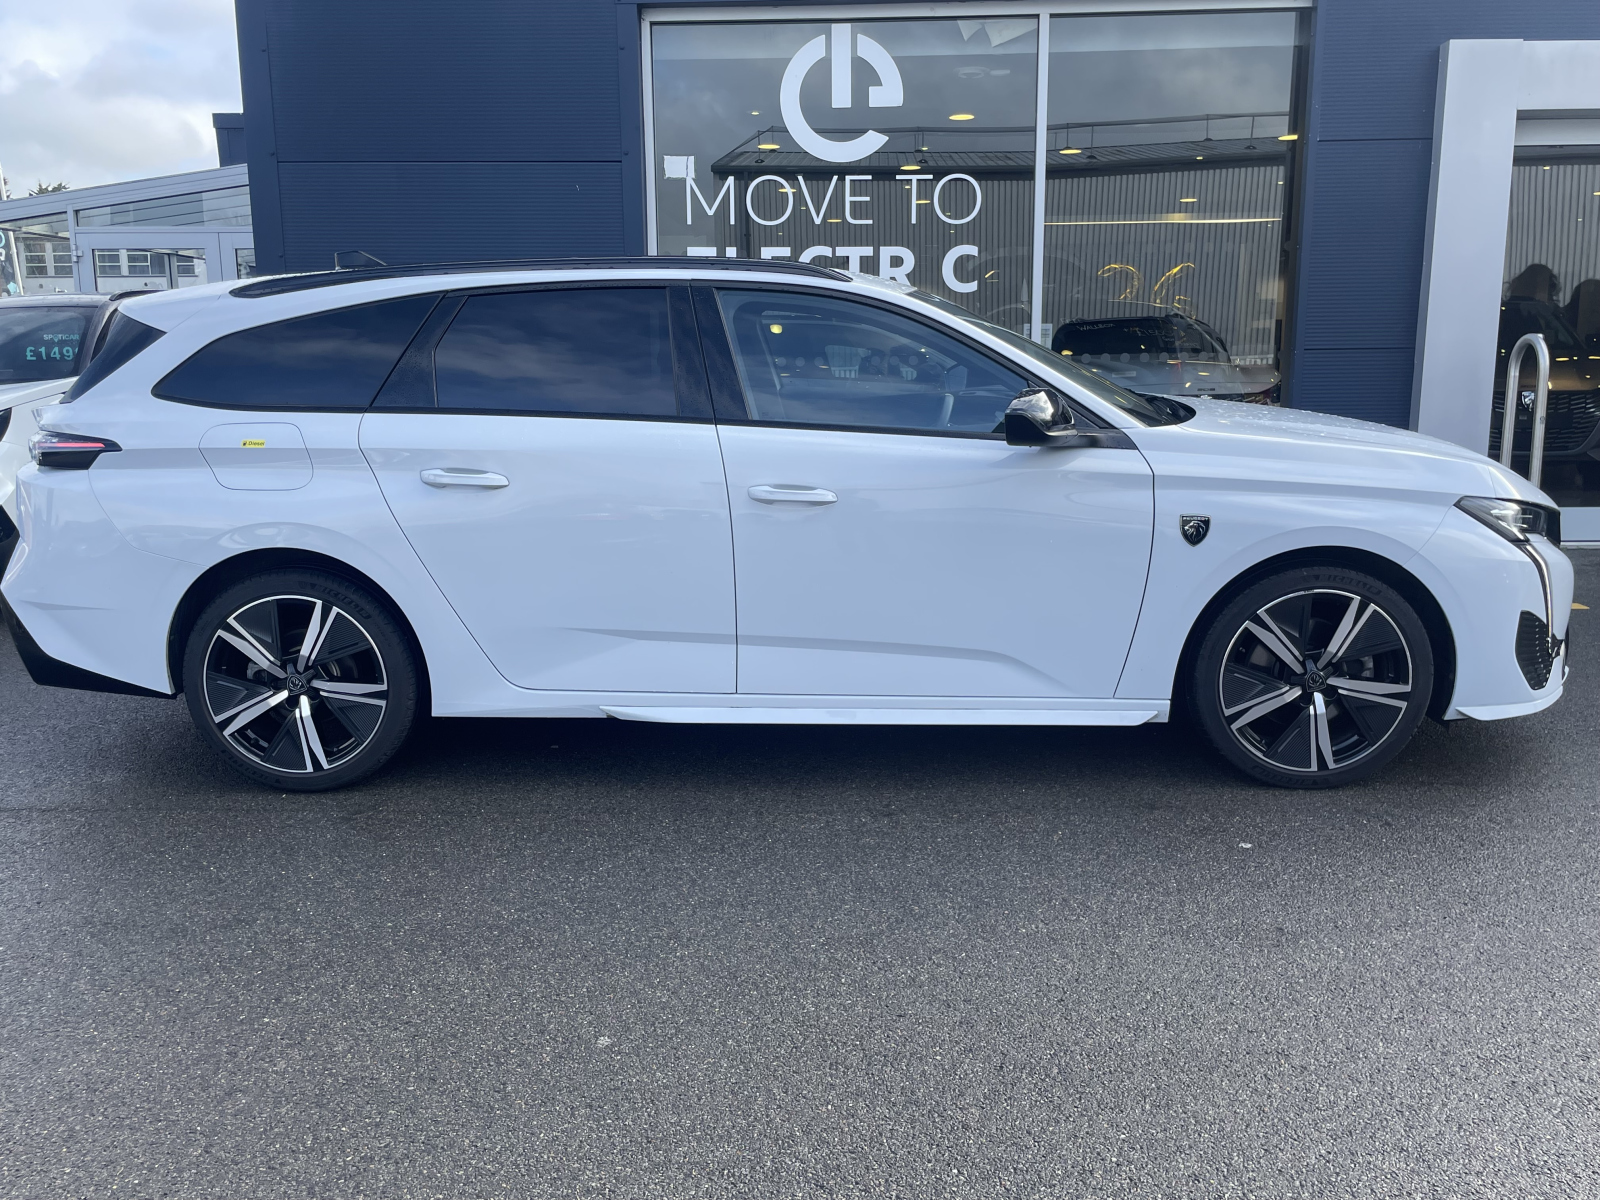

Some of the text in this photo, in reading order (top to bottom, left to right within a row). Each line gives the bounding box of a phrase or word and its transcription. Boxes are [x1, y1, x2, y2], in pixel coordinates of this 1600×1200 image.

[686, 173, 982, 226] MOVE TO
[43, 334, 80, 342] SPOTICAR
[26, 346, 79, 361] £149
[319, 584, 373, 620] MICHELIN
